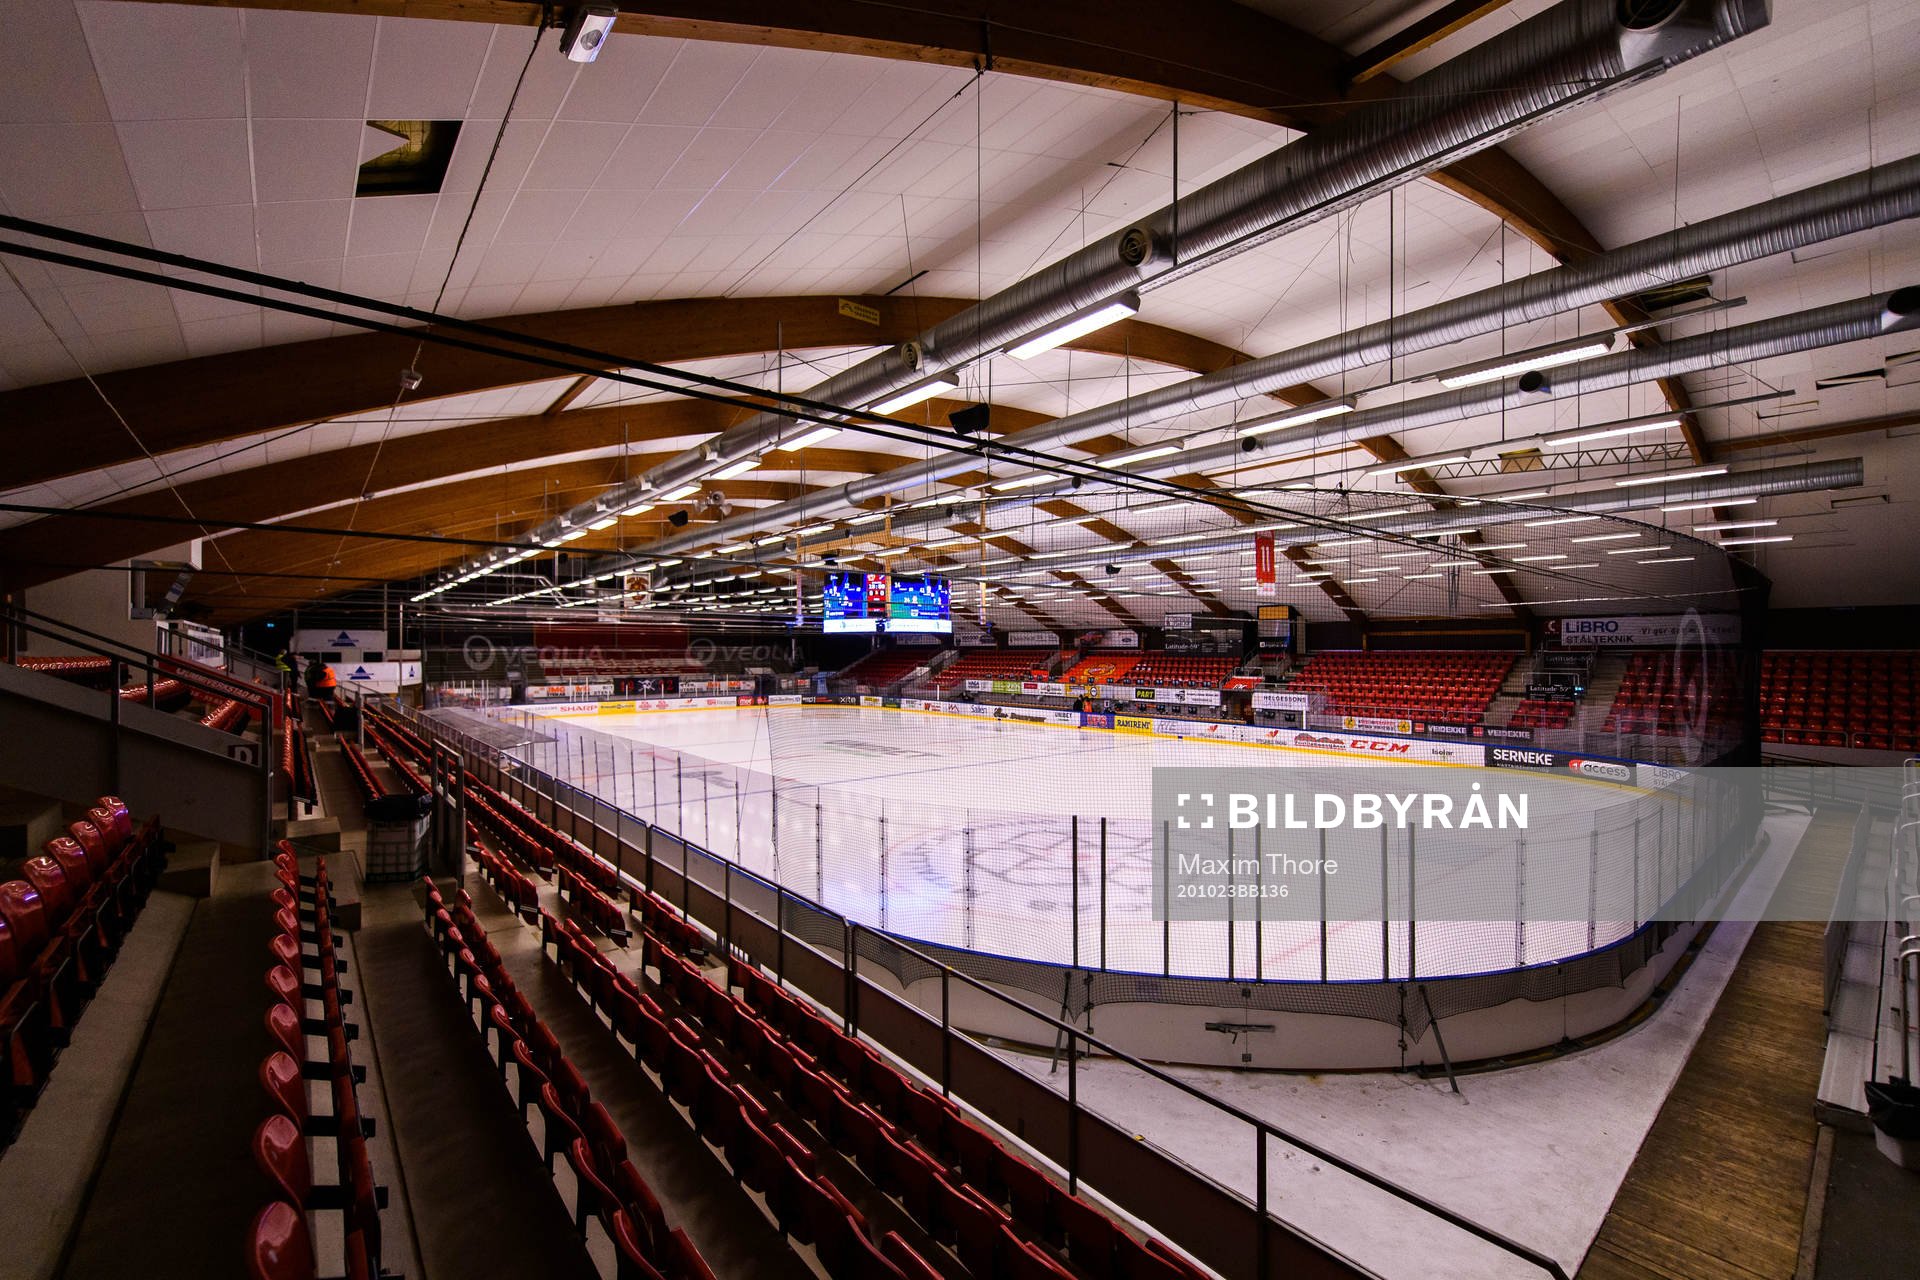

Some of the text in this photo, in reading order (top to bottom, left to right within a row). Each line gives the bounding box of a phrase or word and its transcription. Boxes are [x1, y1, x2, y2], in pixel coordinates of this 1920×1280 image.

[1117, 720, 1150, 730] RAMIRENT
[1428, 725, 1467, 734] VEIDEKKE
[1487, 729, 1530, 739] VEIDEKKE
[1351, 740, 1411, 753] CCM
[1493, 749, 1553, 766] SERNEKE
[1584, 762, 1627, 778] access
